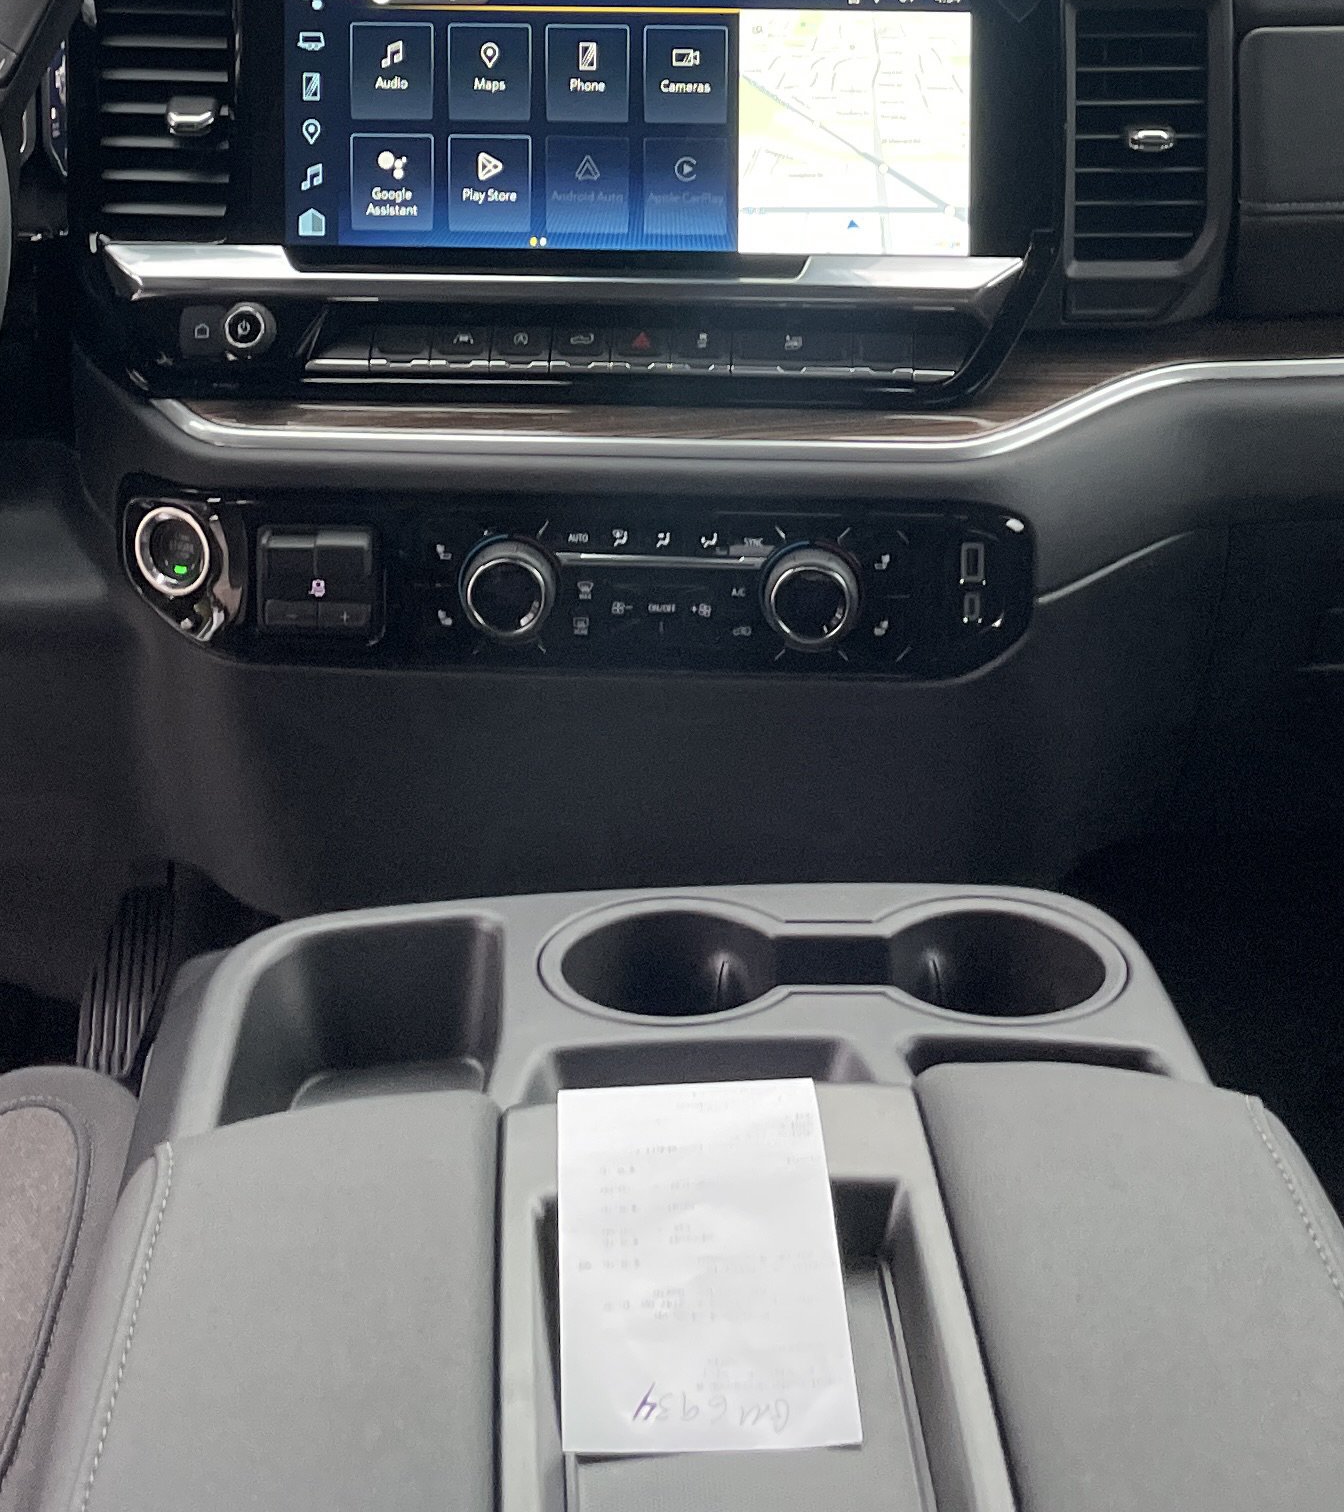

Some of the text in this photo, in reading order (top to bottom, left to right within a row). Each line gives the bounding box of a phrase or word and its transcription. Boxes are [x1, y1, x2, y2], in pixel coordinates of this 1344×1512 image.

[375, 76, 409, 90] Audio
[474, 78, 506, 93] Maps
[569, 78, 606, 93] Phone
[660, 80, 711, 94] Cameras
[372, 187, 413, 203] Google
[462, 188, 517, 204] Play Store
[551, 190, 624, 202] Android Auto
[366, 203, 418, 216] Assistant
[567, 533, 589, 543] AUTO
[731, 588, 746, 597] A/C
